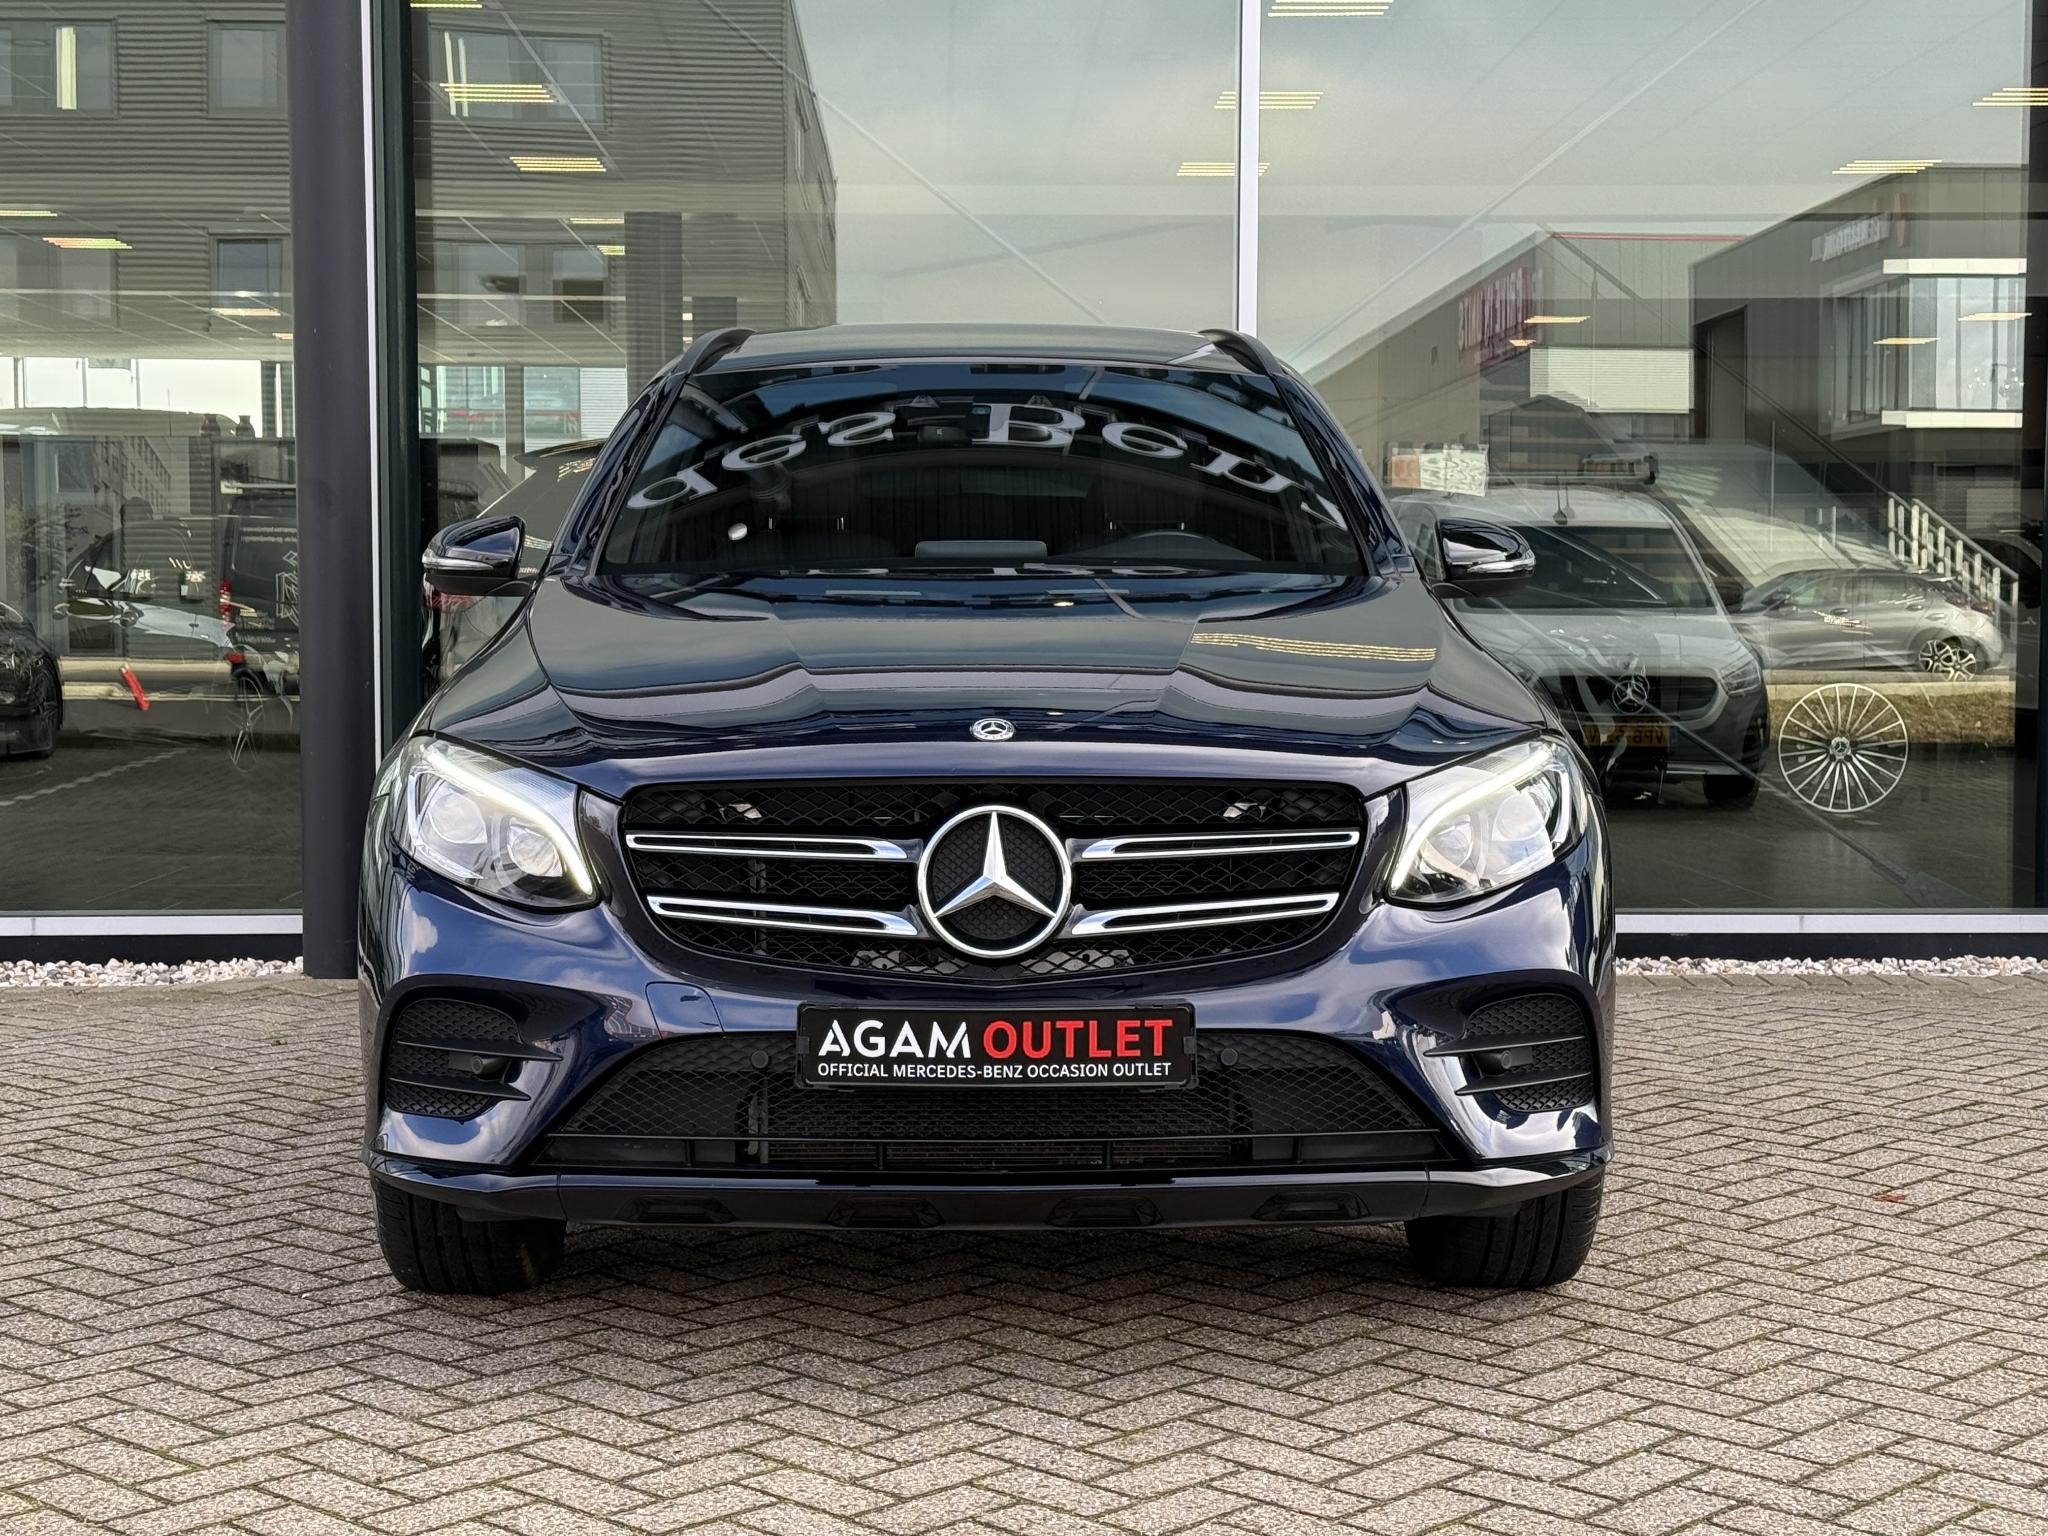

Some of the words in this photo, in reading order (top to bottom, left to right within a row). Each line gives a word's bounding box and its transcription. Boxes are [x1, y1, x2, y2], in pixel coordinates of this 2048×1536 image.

[818, 1019, 971, 1058] AGAM
[983, 1020, 1173, 1058] OUTLET
[817, 1063, 888, 1077] OFFICIAL
[893, 1064, 1023, 1079] MERCEDES-BENZ
[1027, 1063, 1108, 1078] OCCASION
[1113, 1062, 1172, 1076] OUTLET
